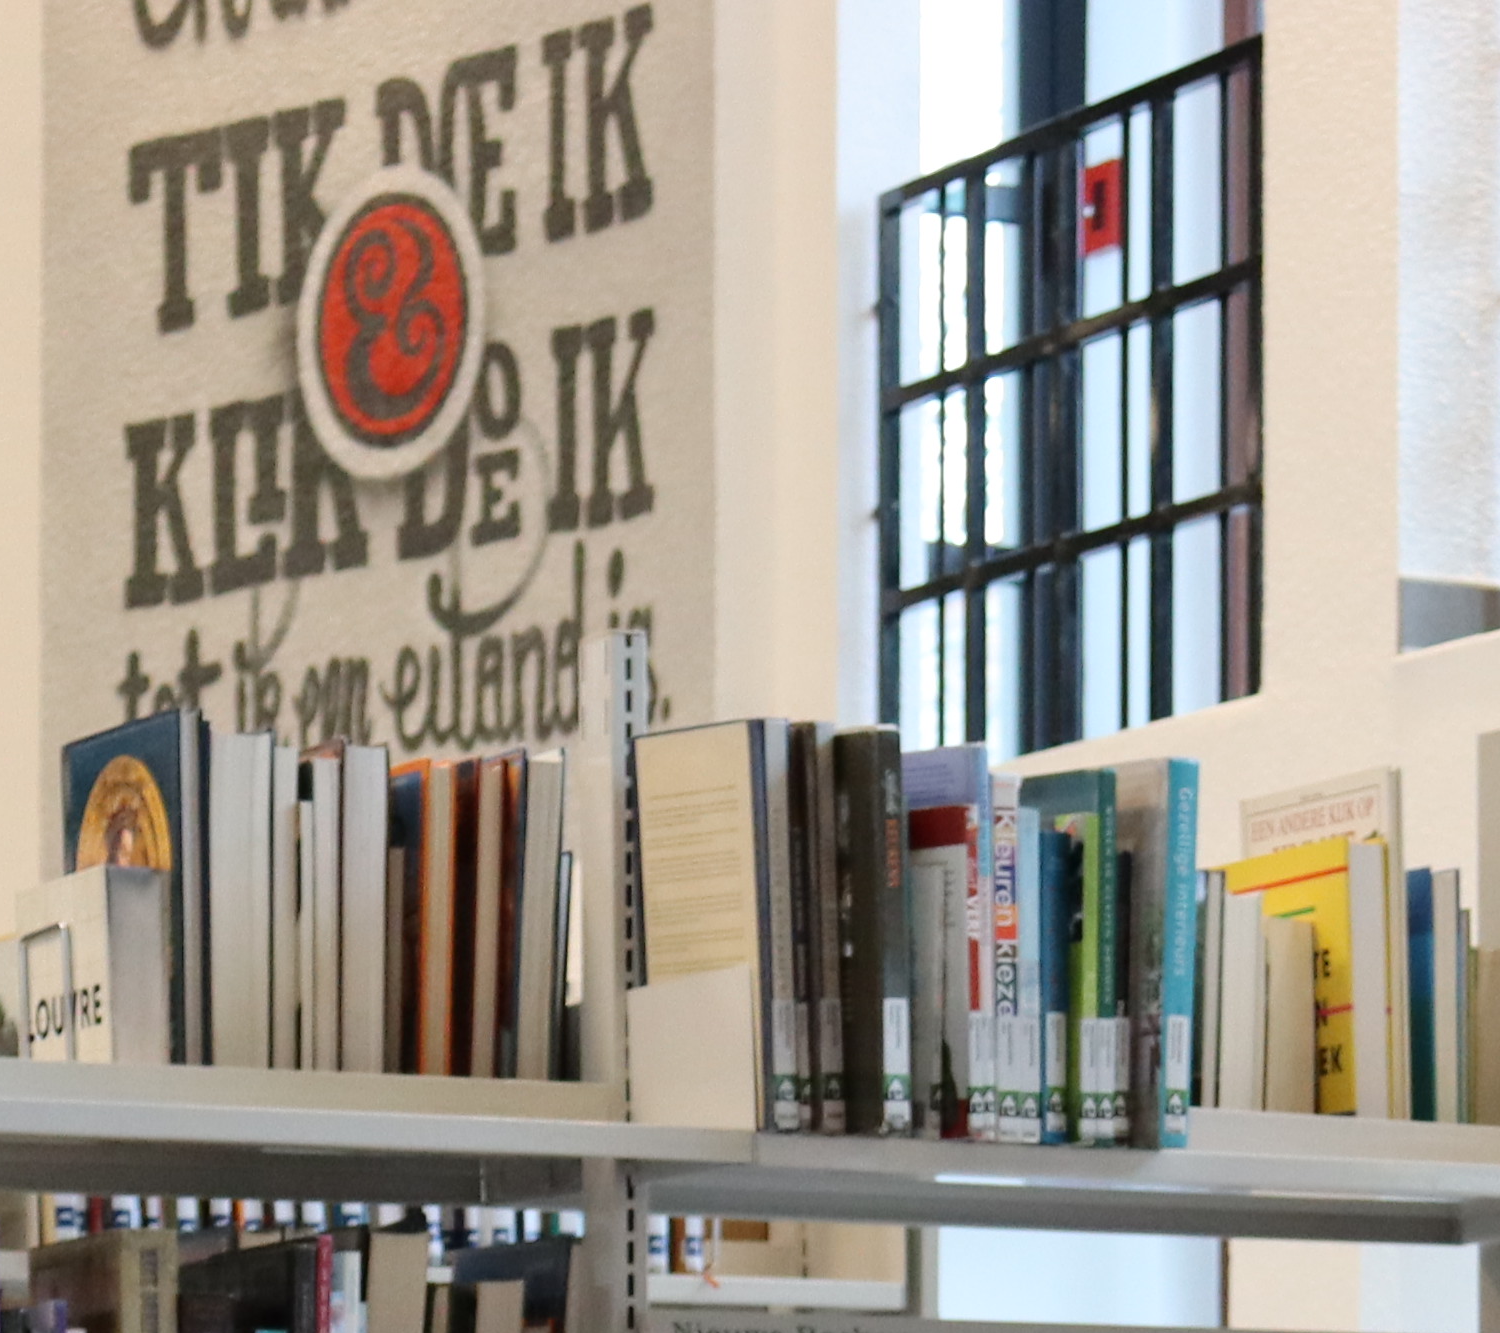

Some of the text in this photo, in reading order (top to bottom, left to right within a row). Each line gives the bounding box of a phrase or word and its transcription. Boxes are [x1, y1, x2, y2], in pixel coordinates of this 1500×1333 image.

[542, 4, 654, 244] IK
[549, 308, 655, 532] IK
[994, 809, 1018, 927] Kleuren
[1173, 787, 1193, 976] Gezellige interieurs
